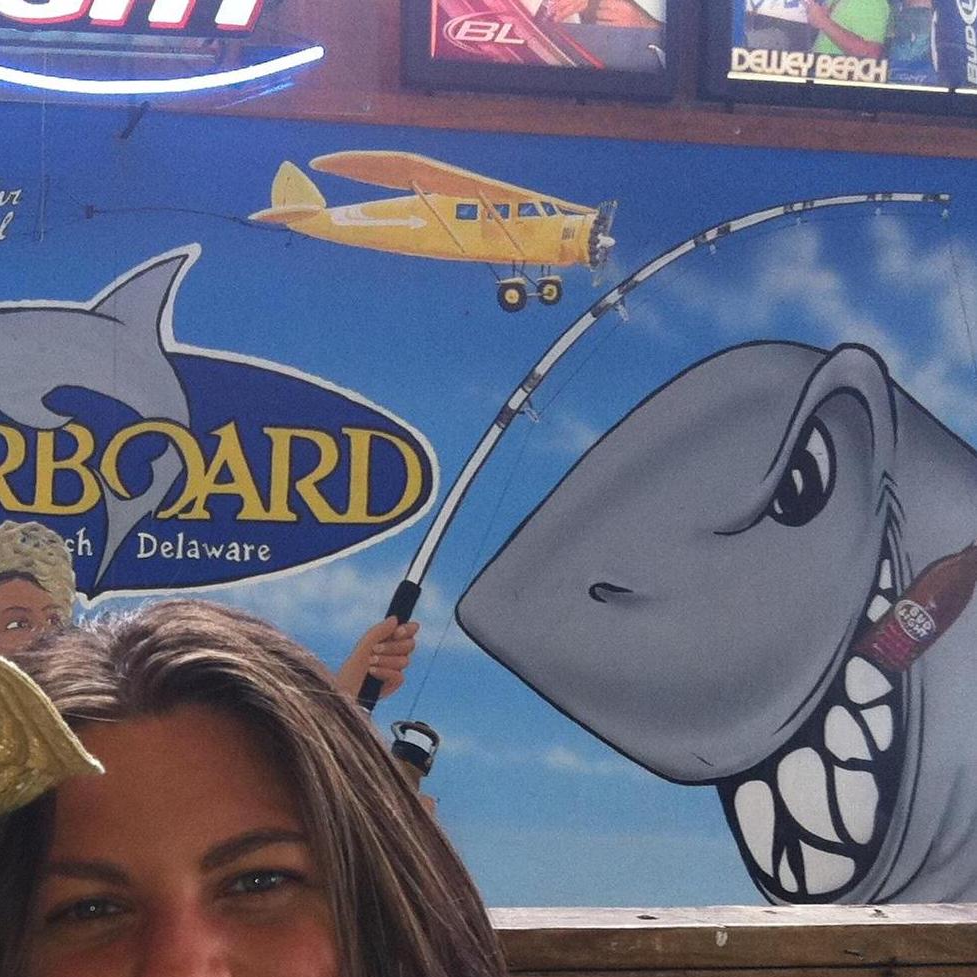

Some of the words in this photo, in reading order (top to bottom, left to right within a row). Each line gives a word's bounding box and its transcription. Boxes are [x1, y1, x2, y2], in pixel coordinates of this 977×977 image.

[455, 20, 524, 44] BL
[731, 47, 814, 77] DEWEY
[816, 54, 888, 83] BEACH
[136, 531, 272, 562] Delaware
